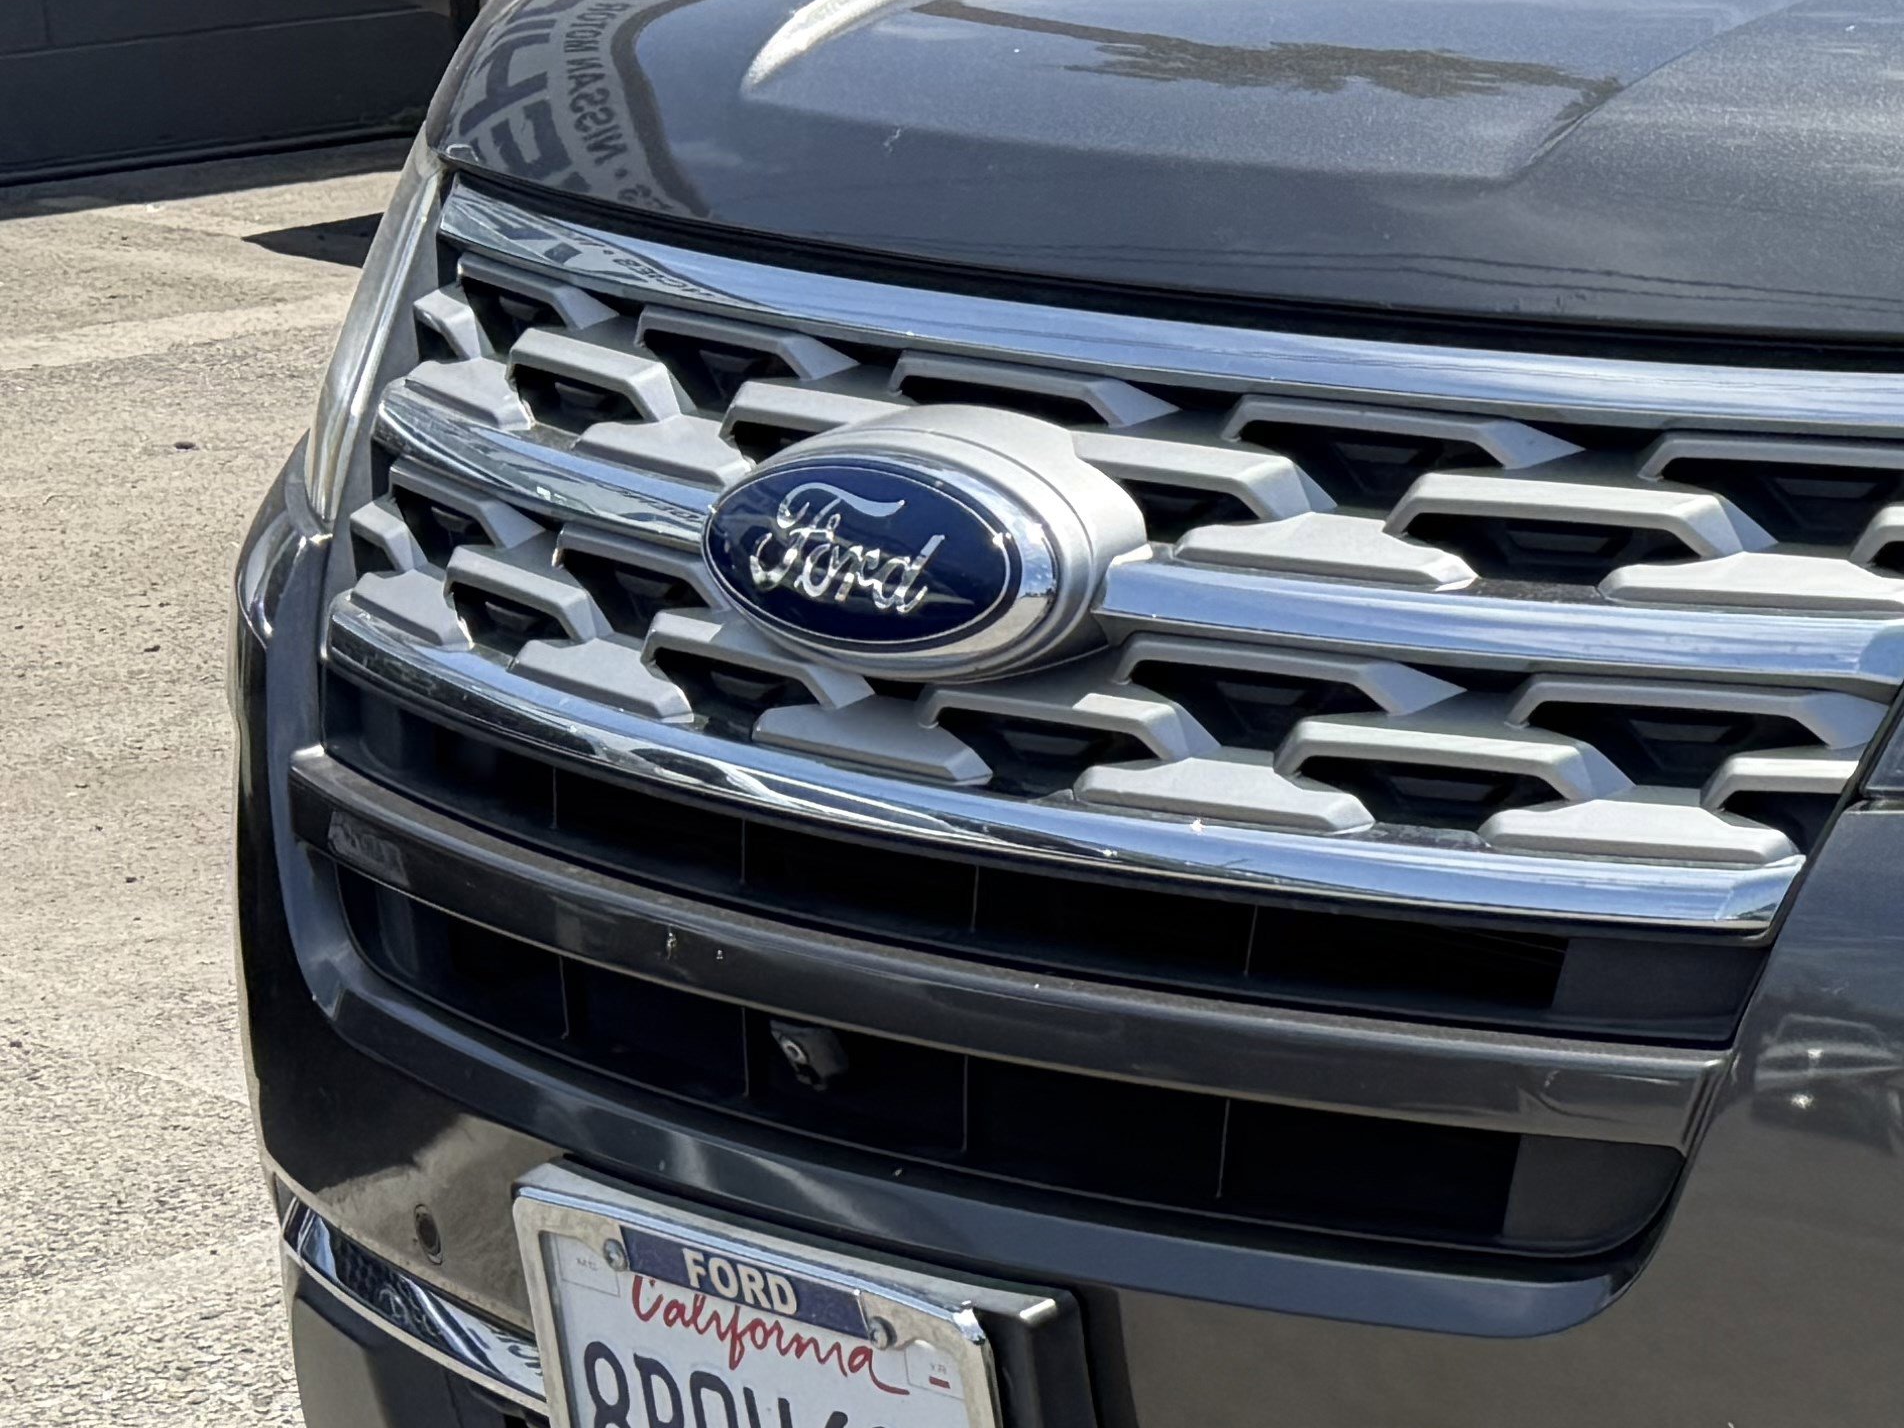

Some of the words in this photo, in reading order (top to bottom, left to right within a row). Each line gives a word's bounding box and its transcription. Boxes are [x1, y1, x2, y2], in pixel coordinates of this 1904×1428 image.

[748, 482, 946, 613] Ford
[631, 1275, 910, 1395] California
[682, 1249, 798, 1316] FORD
